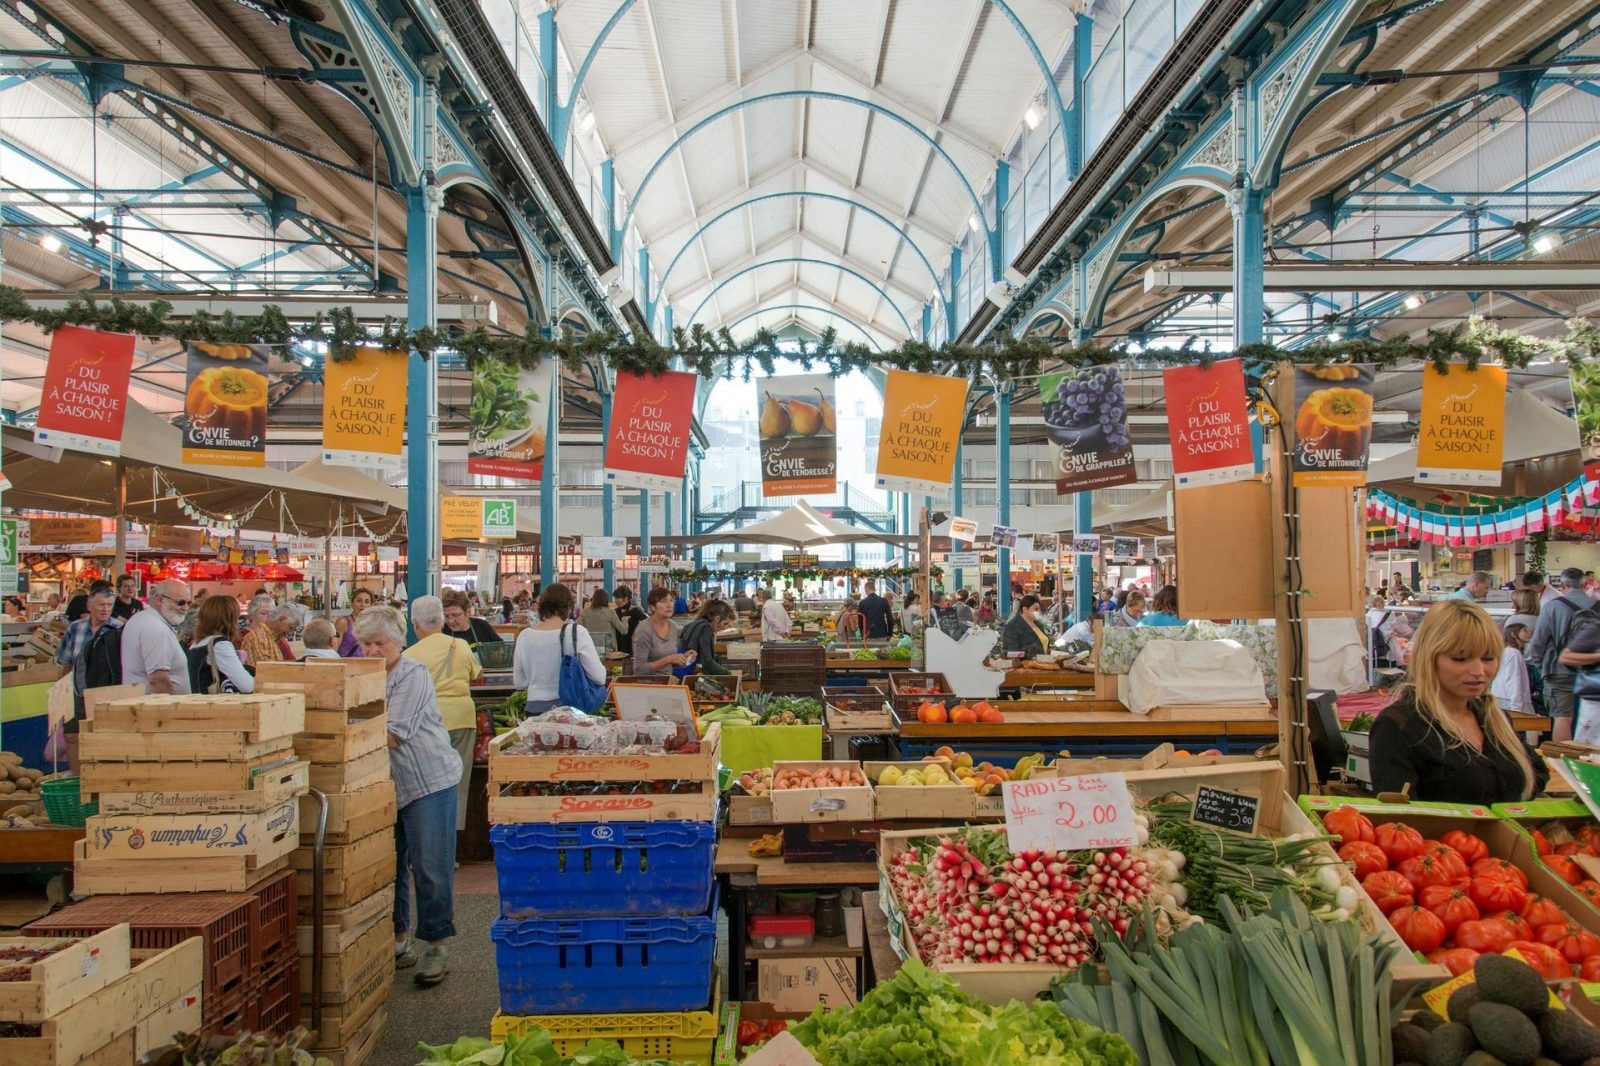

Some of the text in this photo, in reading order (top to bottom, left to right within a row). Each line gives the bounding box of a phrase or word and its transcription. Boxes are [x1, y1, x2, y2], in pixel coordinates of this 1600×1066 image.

[80, 367, 100, 380] DU
[65, 378, 110, 394] PLAISIR
[354, 384, 374, 395] DU
[50, 386, 120, 410] À CHAQUE
[341, 396, 385, 409] PLAISIR
[56, 403, 112, 422] SAISON !
[329, 406, 396, 424] À CHAQUE
[642, 406, 662, 418] DU
[1199, 401, 1219, 413] DU
[1453, 402, 1473, 413] DU
[629, 417, 672, 433] PLAISIR
[912, 411, 932, 423] DU
[1188, 413, 1231, 428] PLAISIR
[1440, 415, 1485, 426] PLAISIR
[190, 419, 229, 443] ENVIE
[336, 422, 390, 437] SAISON !
[616, 426, 681, 448] À CHAQUE
[899, 422, 942, 438] PLAISIR
[1178, 424, 1244, 443] À CHAQUE
[1427, 425, 1496, 441] À CHAQUE
[473, 430, 509, 454] ENVIE
[886, 432, 951, 453] À CHAQUE
[1188, 438, 1240, 455] SAISON !
[1434, 441, 1489, 453] SAISON !
[622, 443, 674, 460] SAISON !
[892, 448, 944, 465] SAISON !
[1300, 442, 1342, 466] ENVIE
[767, 452, 805, 476] ENVIE
[1059, 449, 1099, 473] ENVIE
[486, 508, 509, 524] AB
[1010, 778, 1072, 800] RADIS
[552, 797, 653, 816] Socave
[1088, 837, 1133, 847] FRANCE
